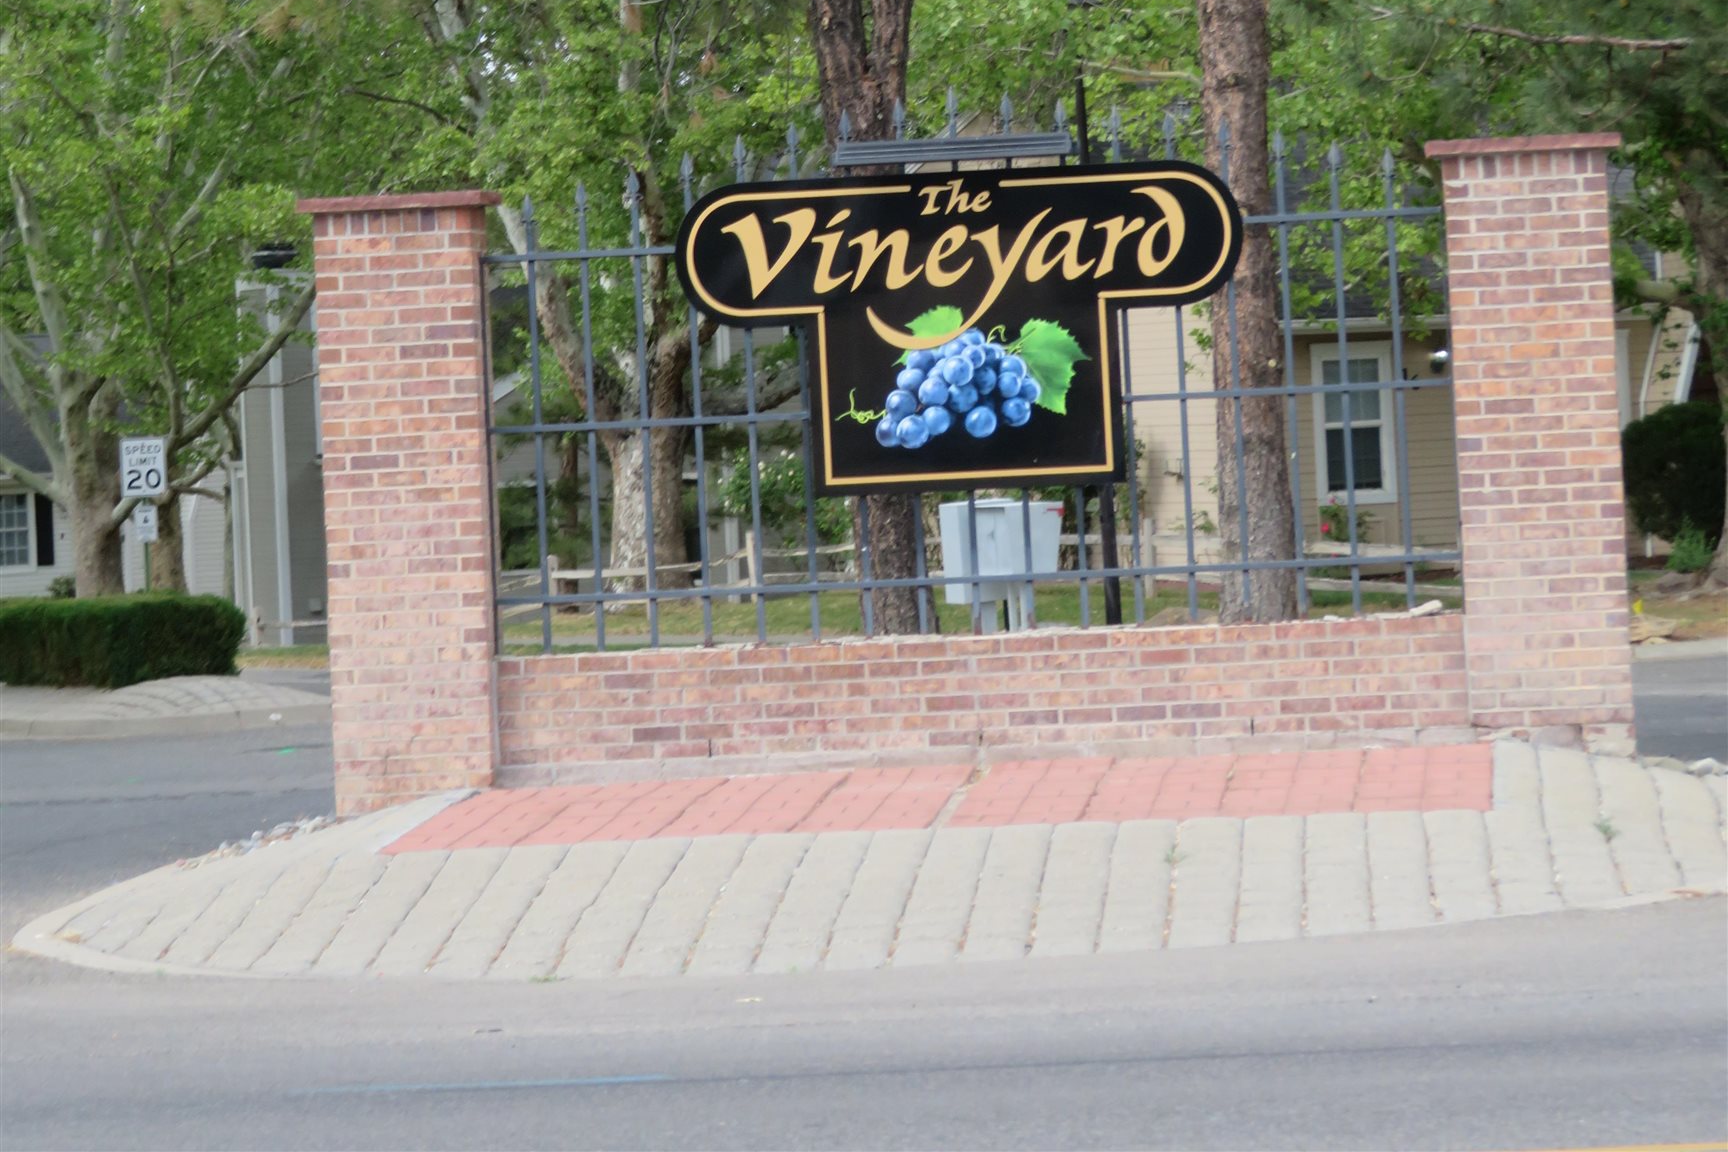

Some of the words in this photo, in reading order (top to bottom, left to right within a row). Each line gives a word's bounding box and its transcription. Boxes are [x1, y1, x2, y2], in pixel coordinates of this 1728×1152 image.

[918, 179, 992, 216] The
[721, 186, 1185, 350] Vineyard
[124, 445, 161, 456] SPEED
[128, 457, 157, 467] LIMIT
[127, 468, 161, 490] 20
